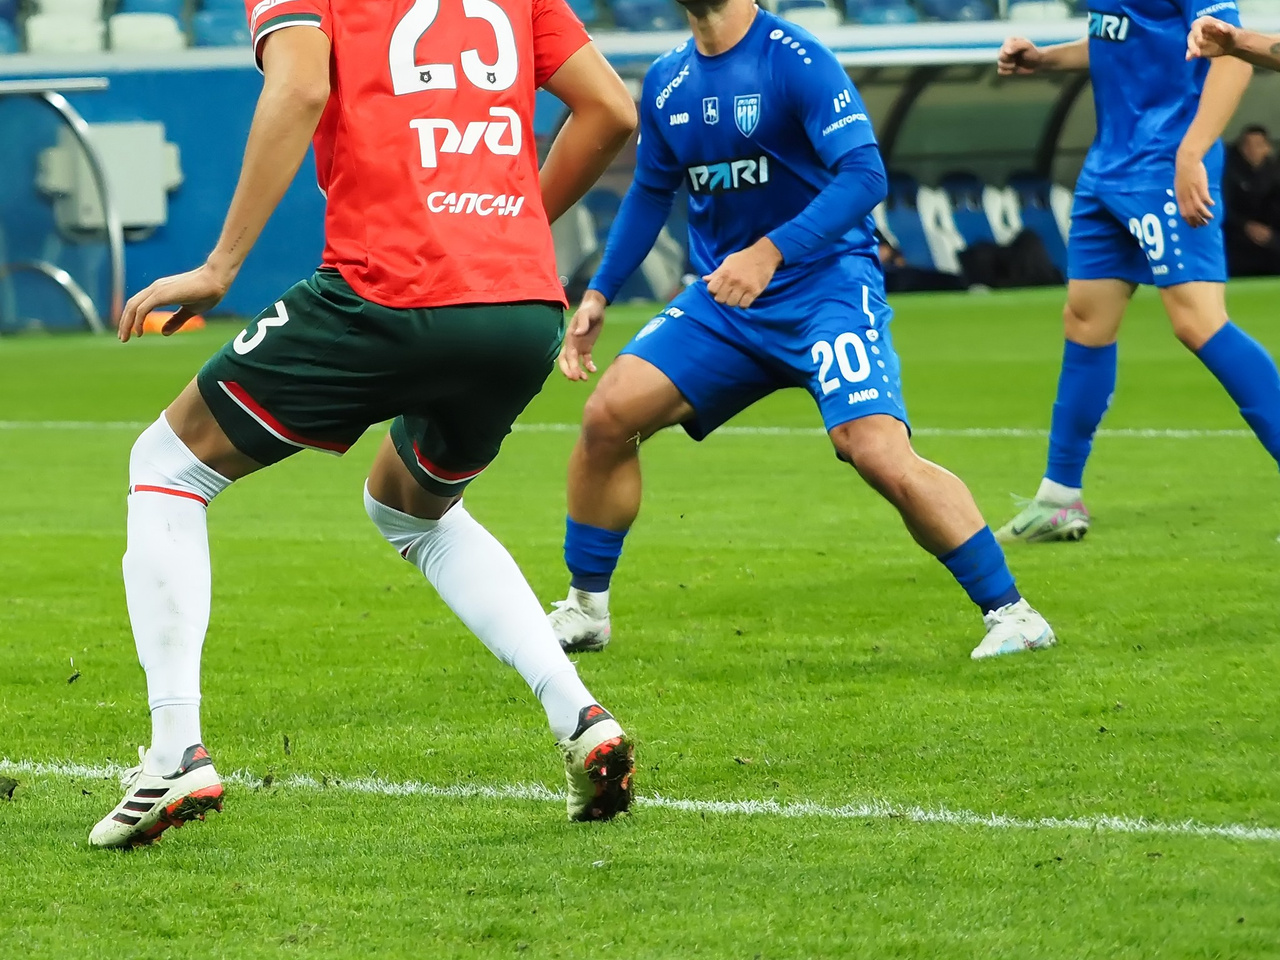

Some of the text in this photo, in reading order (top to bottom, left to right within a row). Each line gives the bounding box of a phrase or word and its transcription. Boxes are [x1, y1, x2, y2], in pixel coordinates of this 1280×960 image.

[1088, 12, 1129, 41] ARI
[669, 112, 690, 127] JAKO
[687, 155, 769, 192] PARI
[426, 191, 525, 217] САПСАН
[811, 331, 871, 396] 20
[847, 387, 880, 406] JAKO
